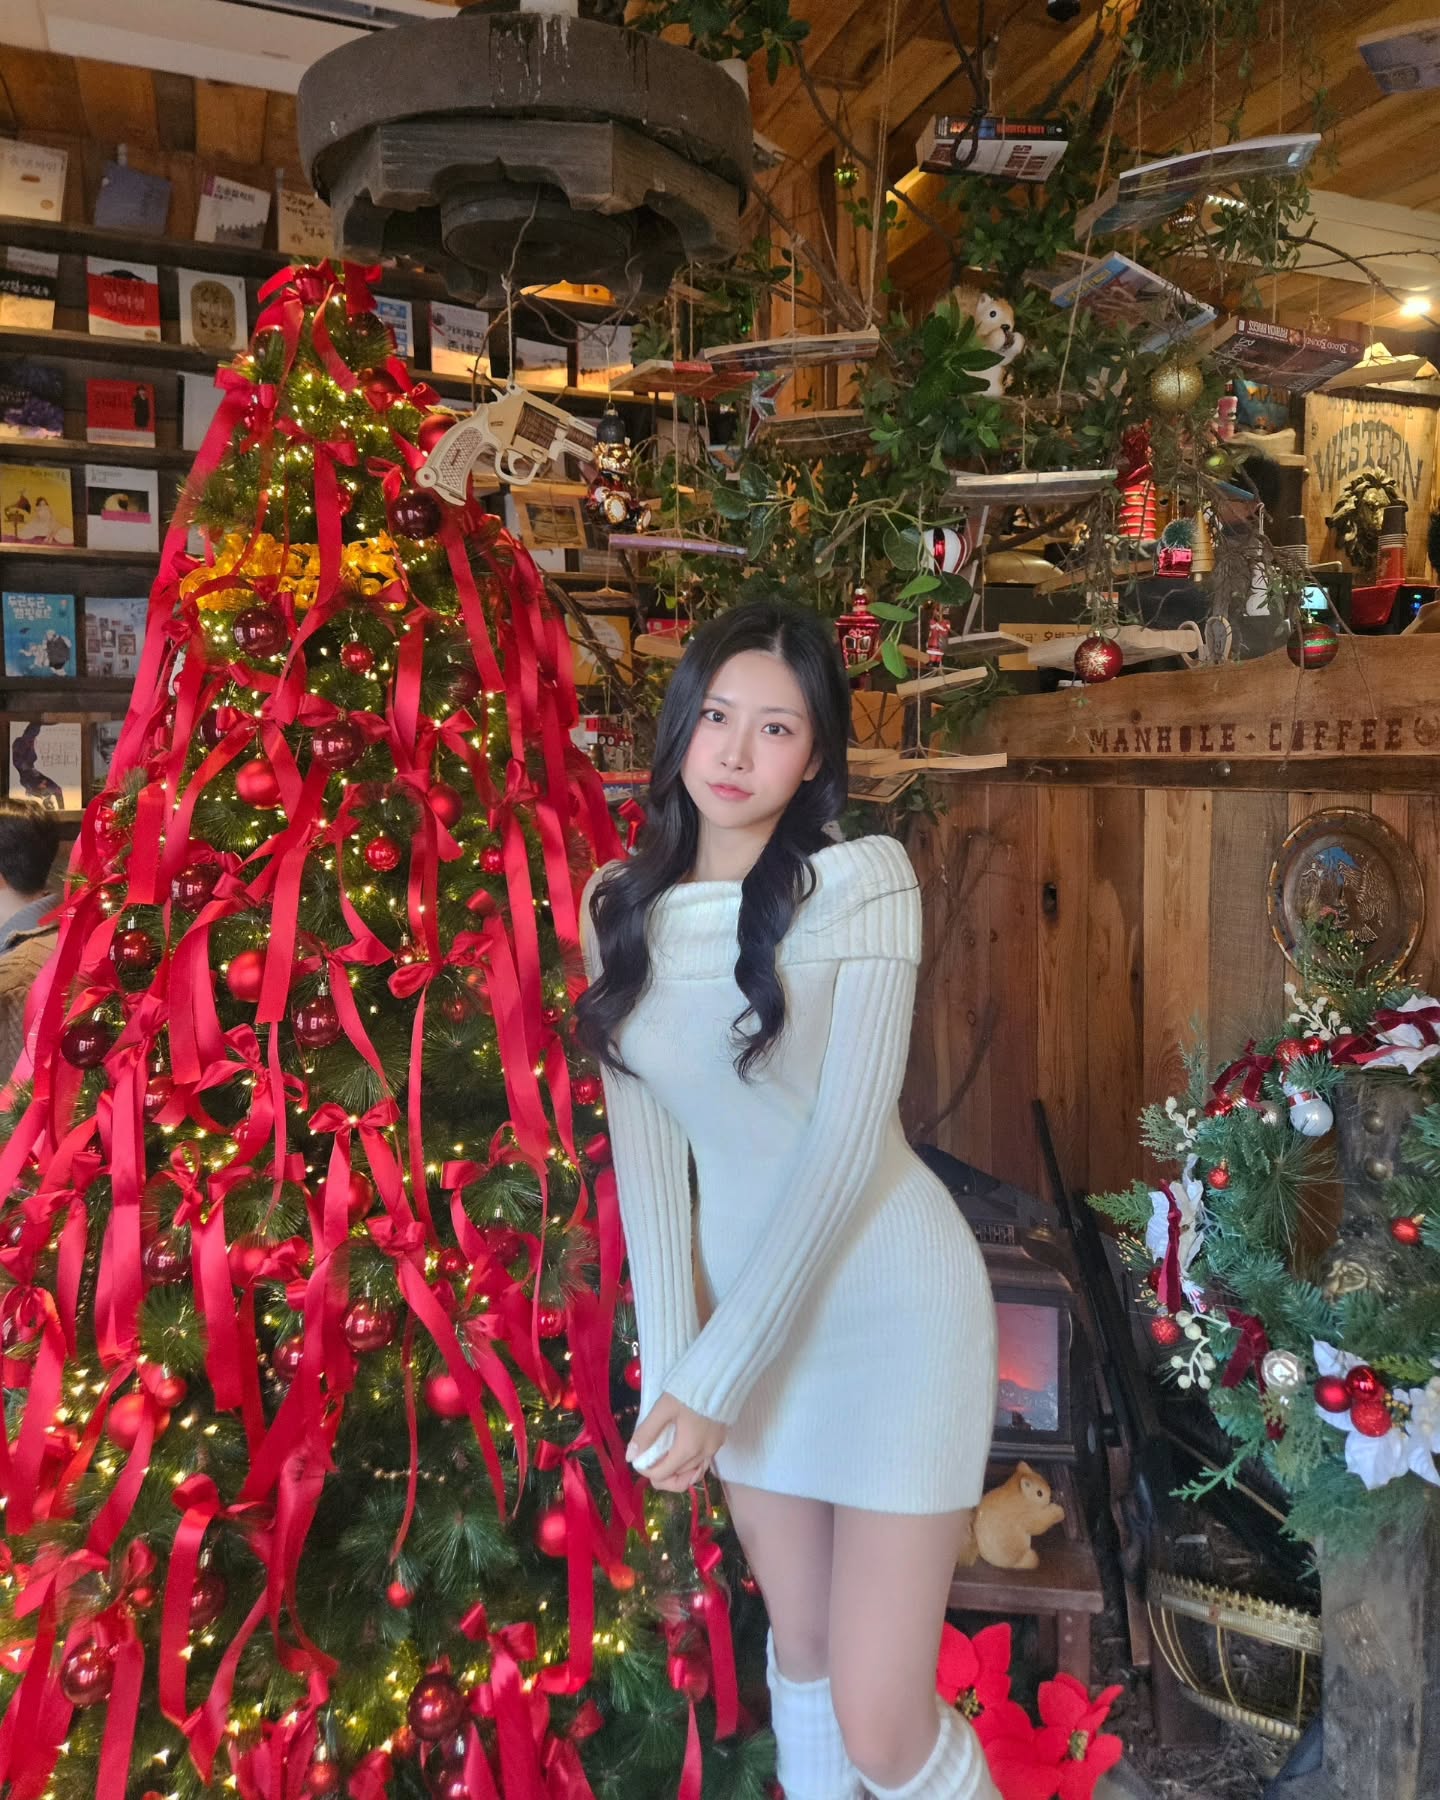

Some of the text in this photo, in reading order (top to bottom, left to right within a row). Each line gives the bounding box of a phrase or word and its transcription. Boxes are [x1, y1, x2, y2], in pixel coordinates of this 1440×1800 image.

[1327, 341, 1349, 354] BLOOD
[1313, 418, 1424, 501] WESTERN
[1089, 718, 1403, 753] MANHOLE COFFEE
